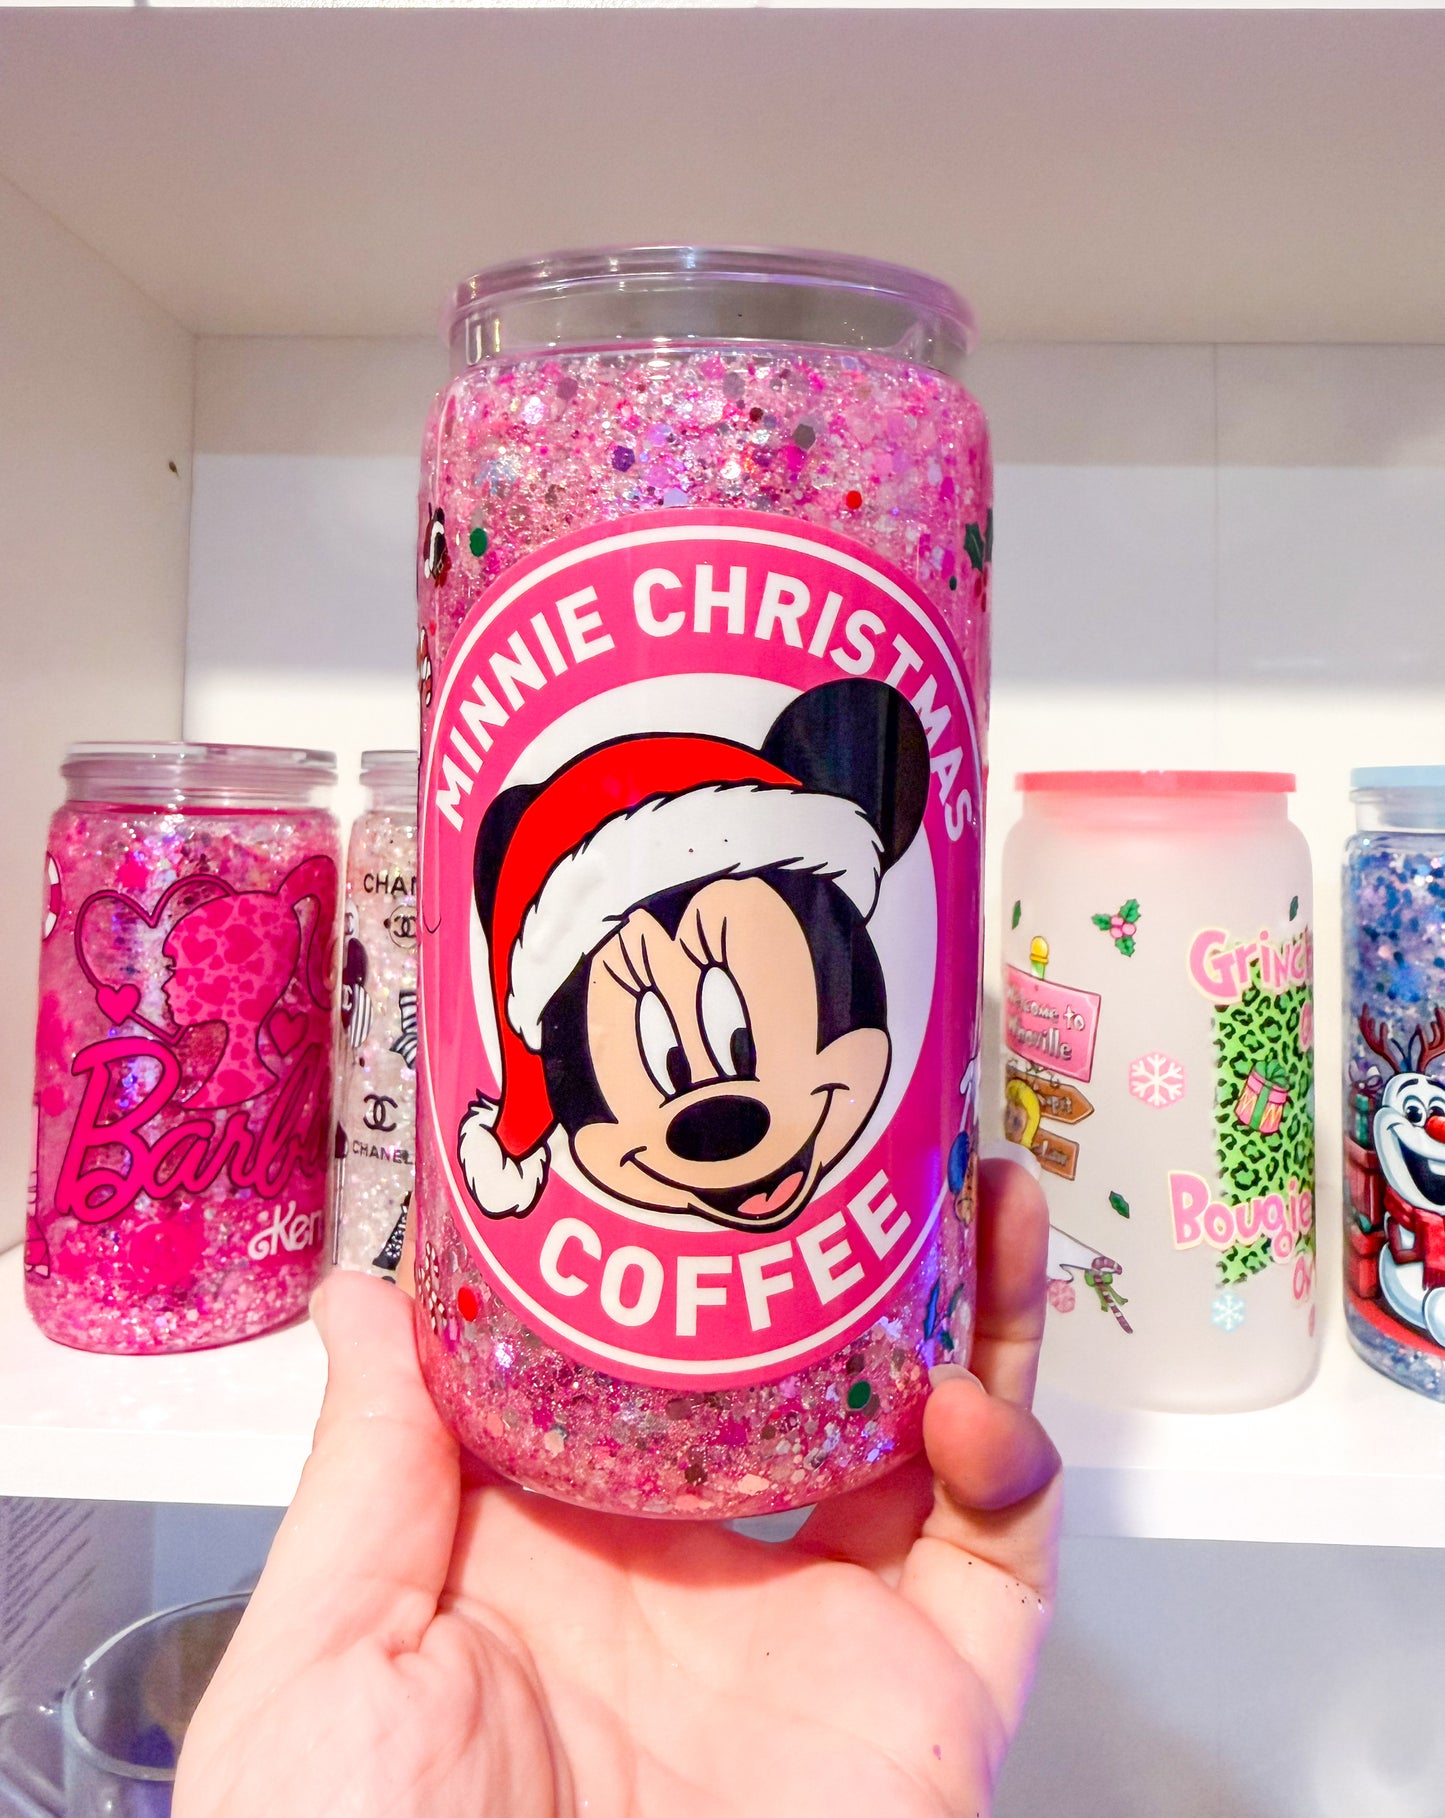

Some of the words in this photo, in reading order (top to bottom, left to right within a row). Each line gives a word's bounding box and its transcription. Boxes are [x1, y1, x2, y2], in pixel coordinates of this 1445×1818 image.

[434, 585, 615, 832] MINNIE
[632, 565, 977, 843] CHRISTMAS
[1063, 1004, 1085, 1031] to
[54, 1036, 330, 1224] Barbi
[352, 1140, 413, 1165] CHANEL
[538, 1167, 913, 1338] COFFEE
[1170, 1172, 1312, 1258] Bougie
